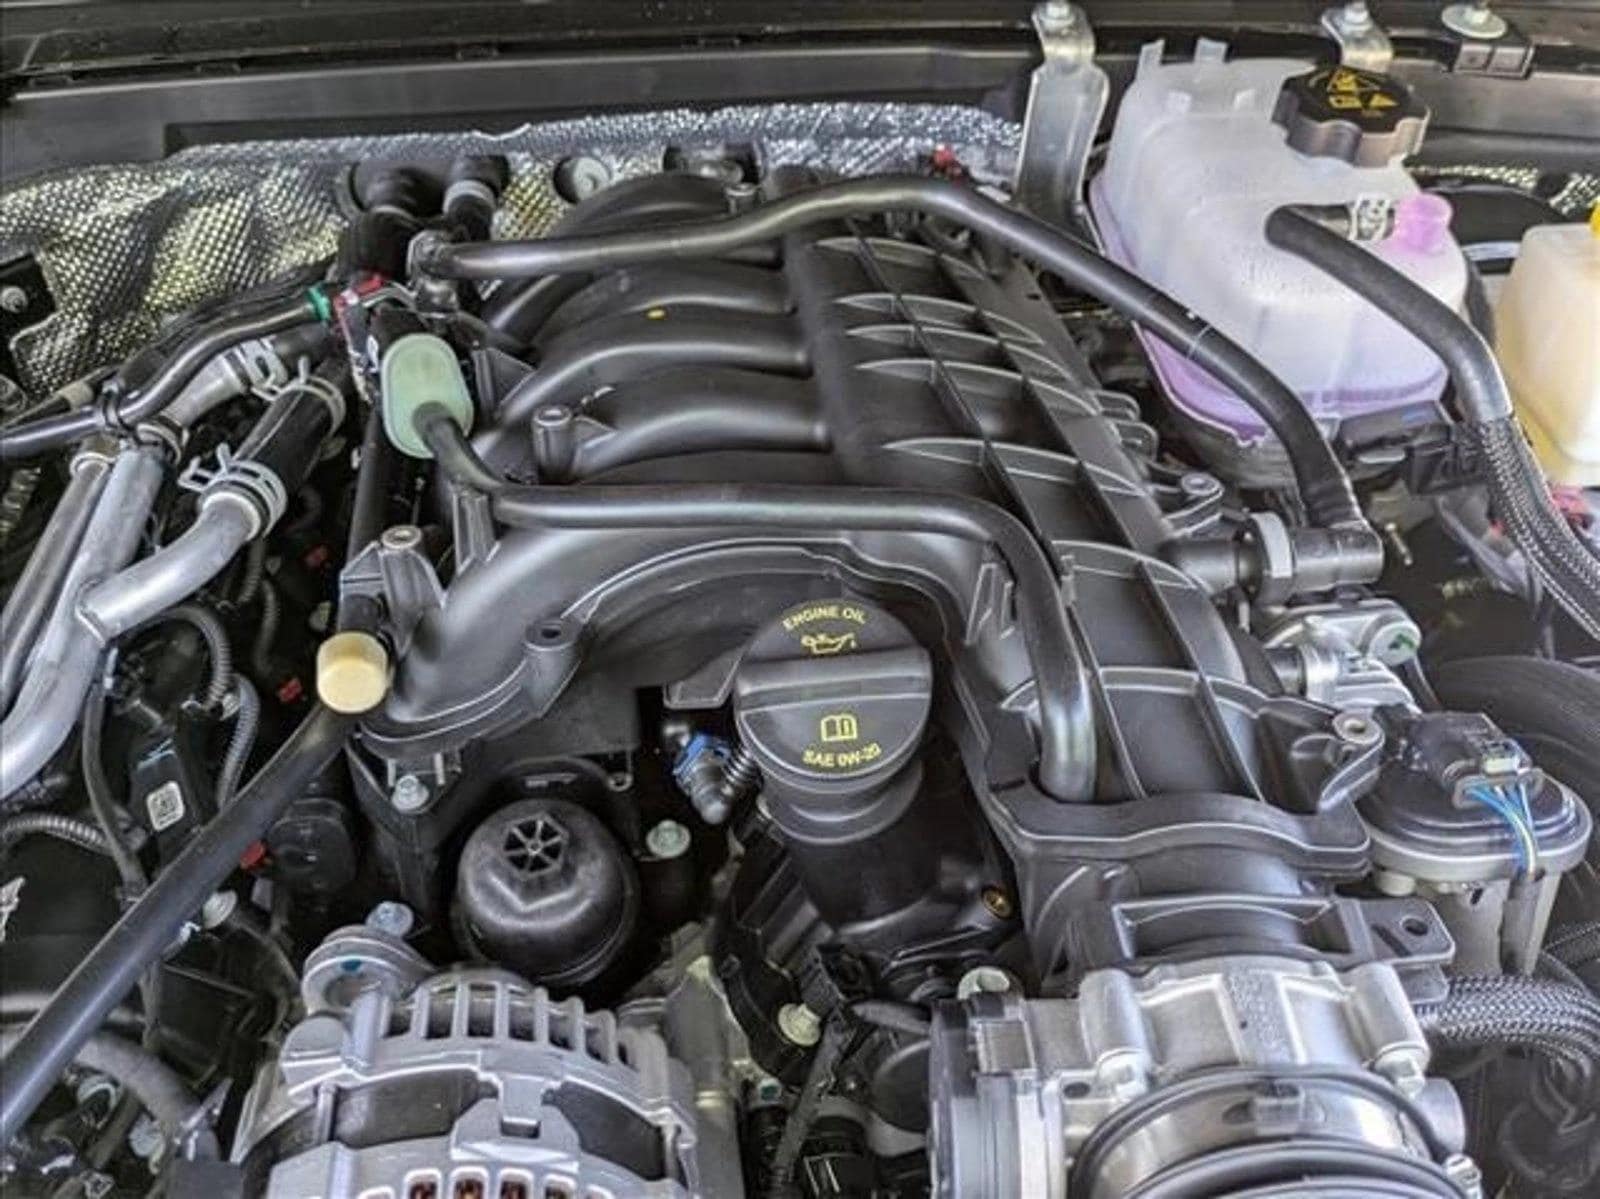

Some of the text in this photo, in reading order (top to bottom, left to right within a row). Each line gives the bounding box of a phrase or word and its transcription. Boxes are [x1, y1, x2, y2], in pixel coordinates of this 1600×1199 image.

[782, 605, 866, 630] ENGINE OIL
[802, 749, 835, 767] SAE
